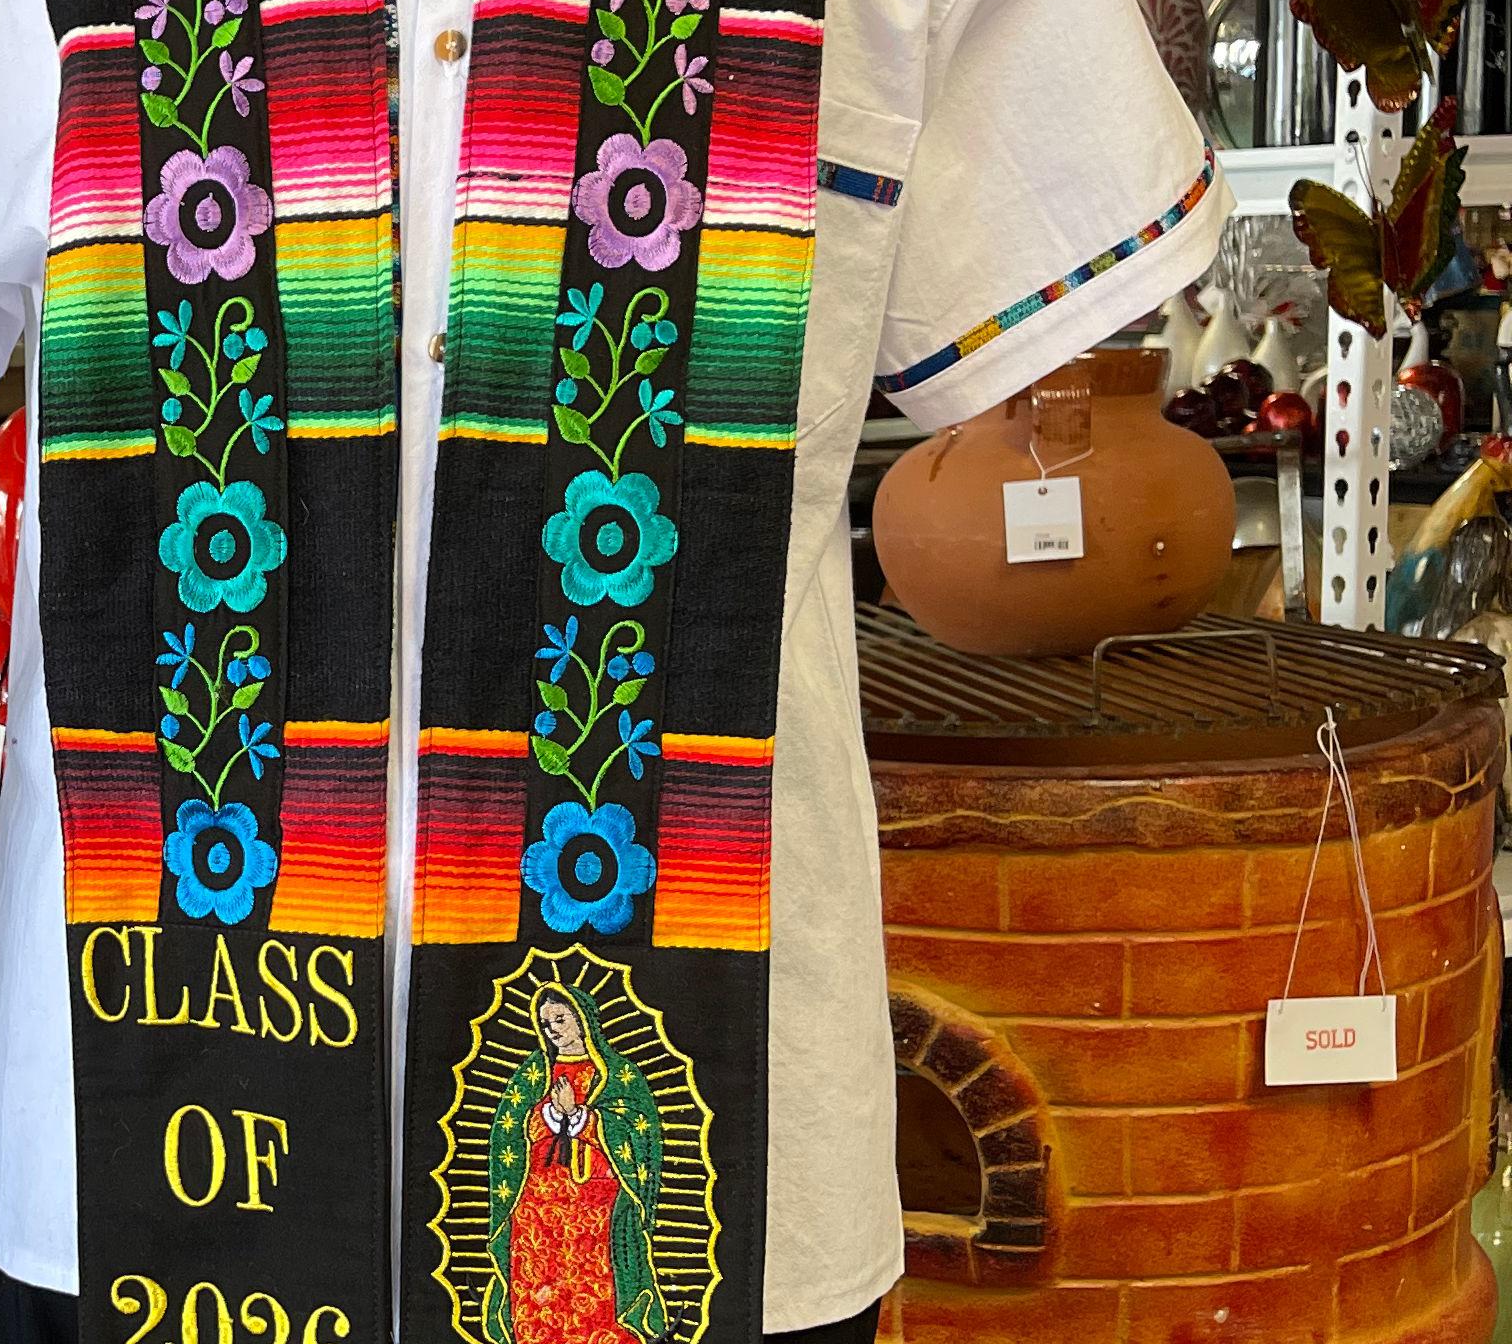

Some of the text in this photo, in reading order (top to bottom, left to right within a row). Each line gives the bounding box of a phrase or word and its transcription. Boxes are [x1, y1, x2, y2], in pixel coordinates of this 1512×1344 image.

[81, 925, 359, 1048] CLASS
[1305, 1028, 1356, 1050] SOLD
[164, 1104, 288, 1212] OF
